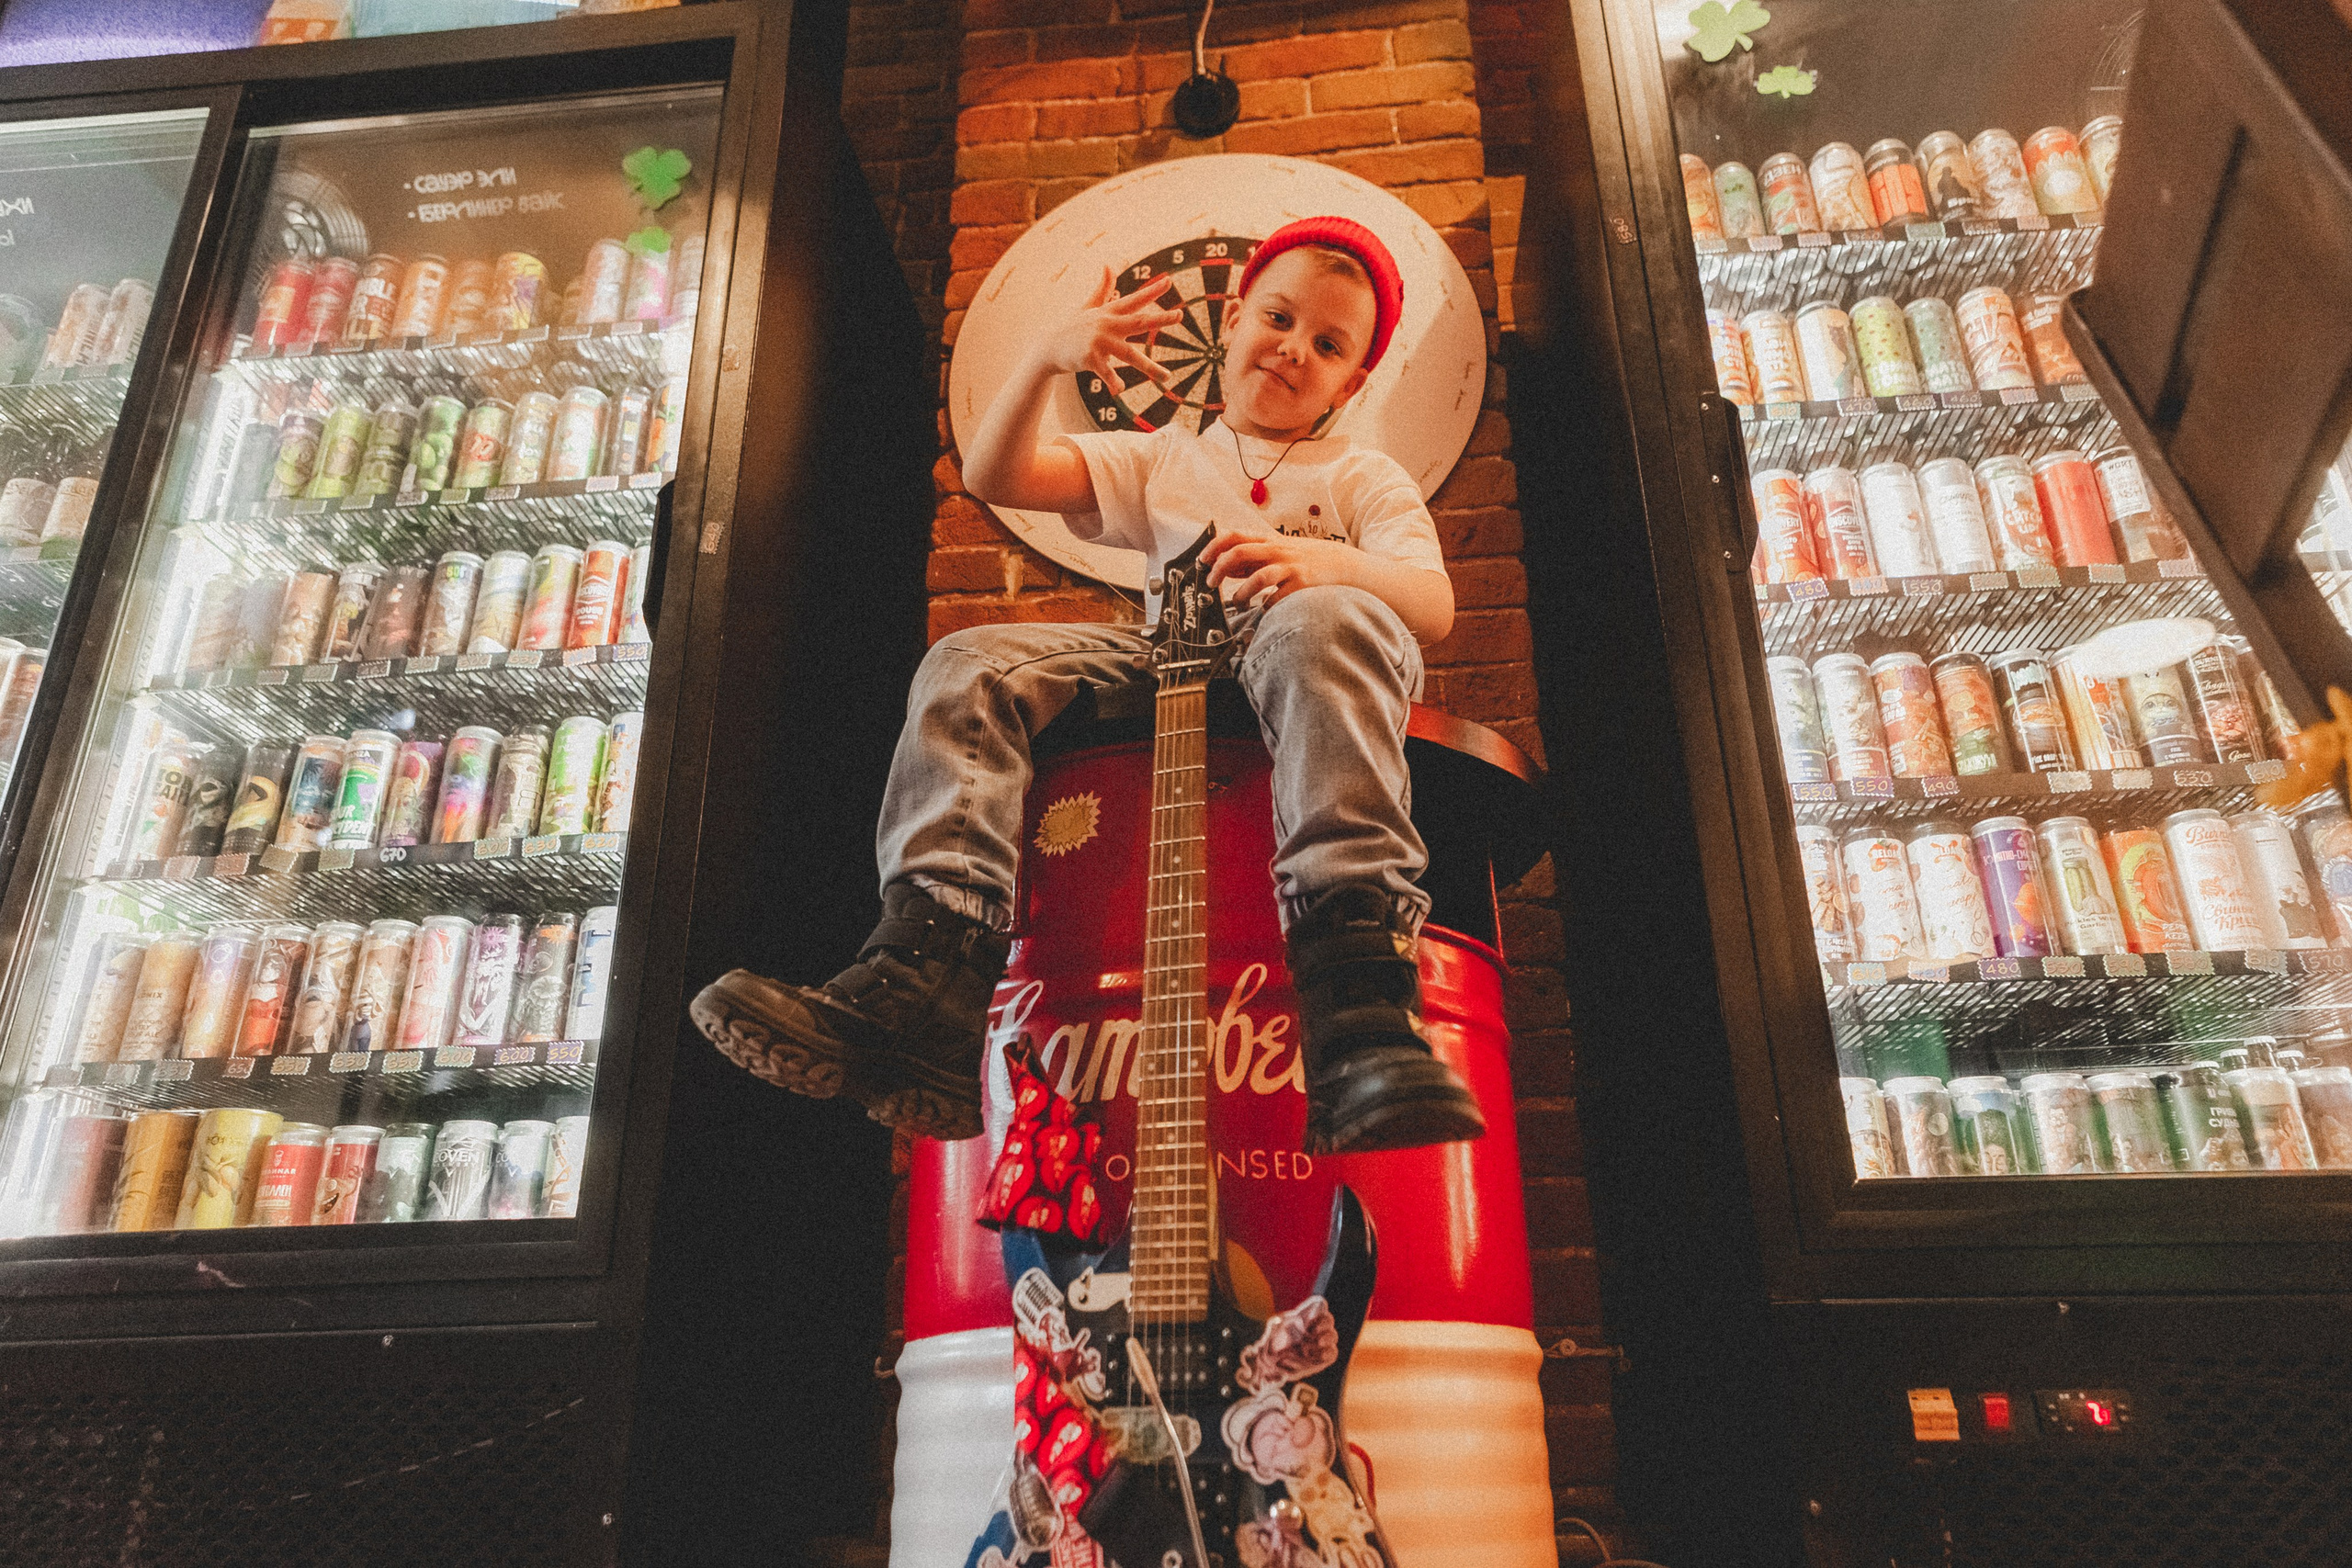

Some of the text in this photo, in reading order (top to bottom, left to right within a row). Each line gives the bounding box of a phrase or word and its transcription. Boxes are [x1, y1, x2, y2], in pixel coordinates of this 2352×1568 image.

[1172, 249, 1185, 265] 5
[1205, 243, 1228, 257] 20
[1132, 265, 1152, 280] 12
[1090, 378, 1103, 393] 8
[1098, 406, 1118, 422] 16
[1794, 583, 1824, 596] 480
[1909, 581, 1942, 593] 550
[1800, 786, 1833, 799] 550
[1855, 781, 1888, 793] 550
[1928, 782, 1955, 793] 490
[524, 839, 557, 855] 630
[583, 836, 617, 850] 620
[379, 847, 407, 863] 670
[2309, 953, 2343, 968] 570
[1852, 967, 1883, 980] 610
[1985, 963, 2019, 975] 480
[499, 1049, 529, 1062] 600
[548, 1046, 582, 1060] 550
[334, 1055, 367, 1067] 630
